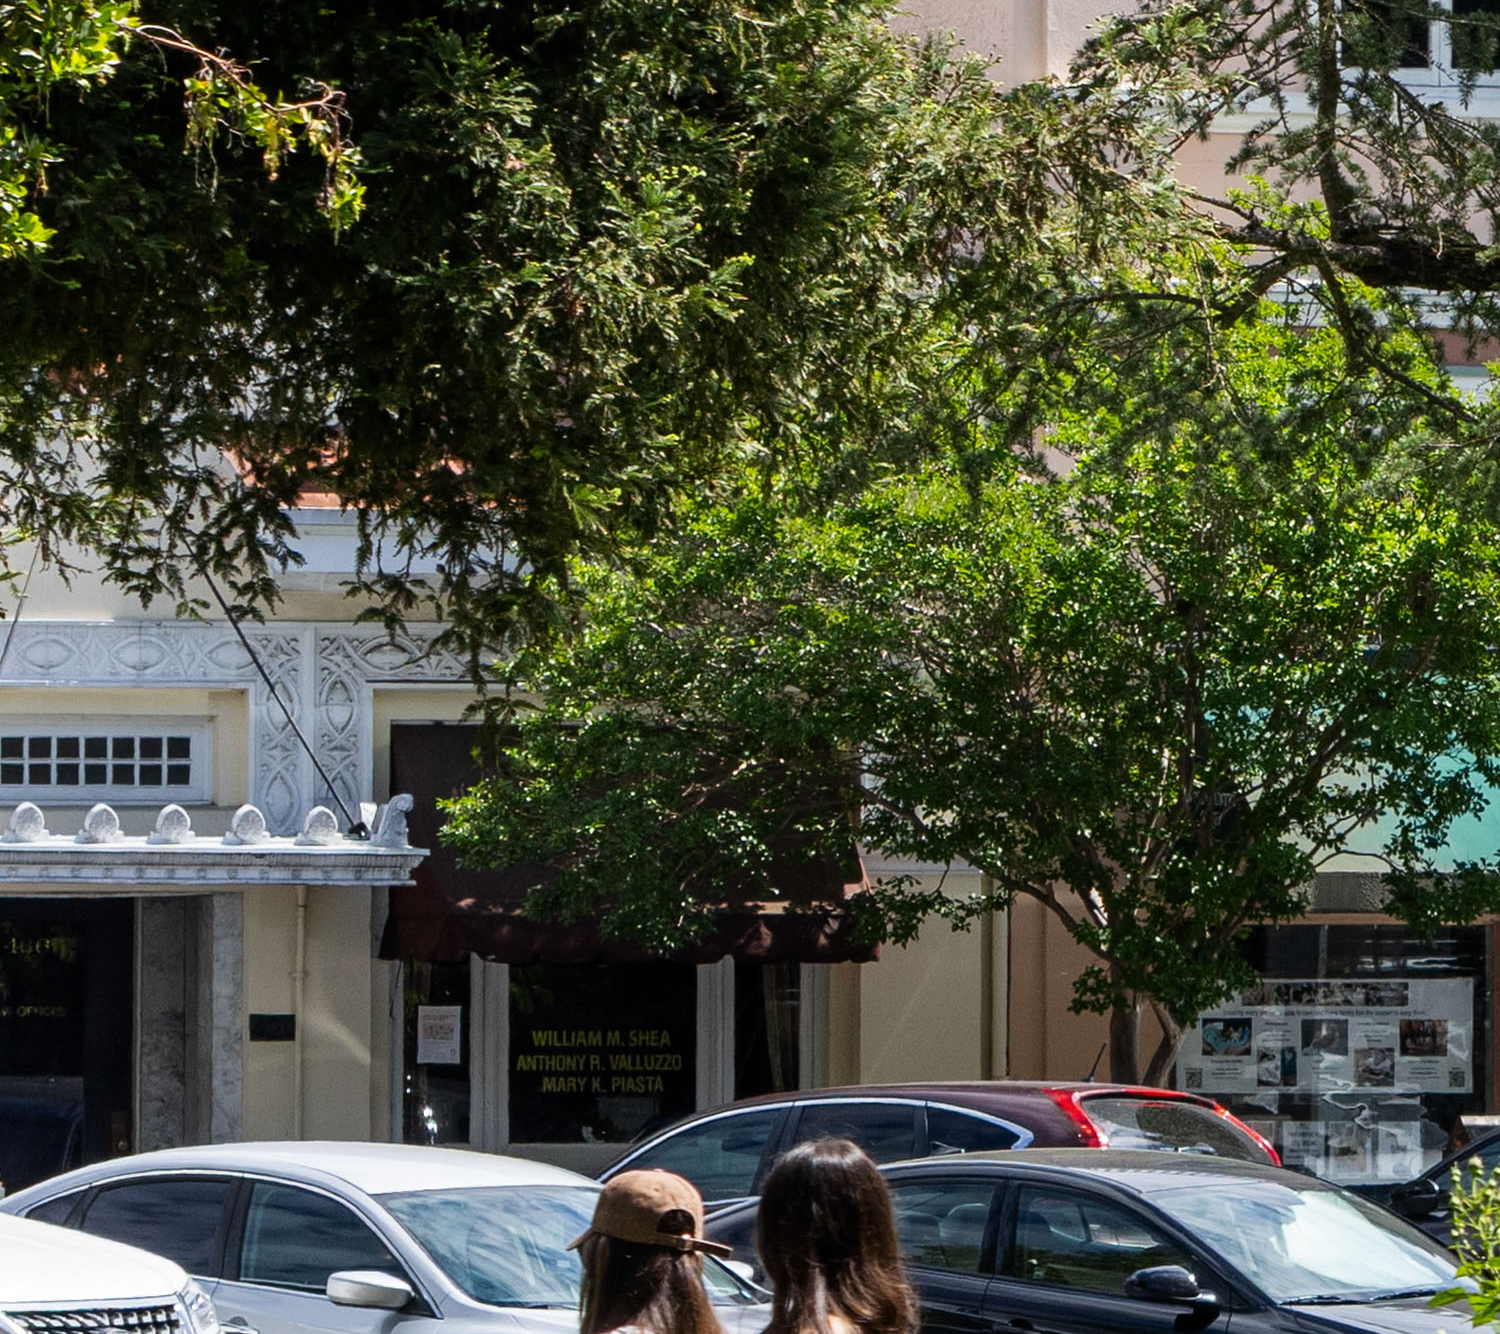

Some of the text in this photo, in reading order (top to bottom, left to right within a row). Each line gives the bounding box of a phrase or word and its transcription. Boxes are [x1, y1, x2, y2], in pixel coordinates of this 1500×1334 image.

[532, 1030, 671, 1047] WILLIAM M. SHEA
[516, 1053, 682, 1071] ANTHONY R. VALLUZZO
[542, 1075, 664, 1093] MARY K. PIASTA
